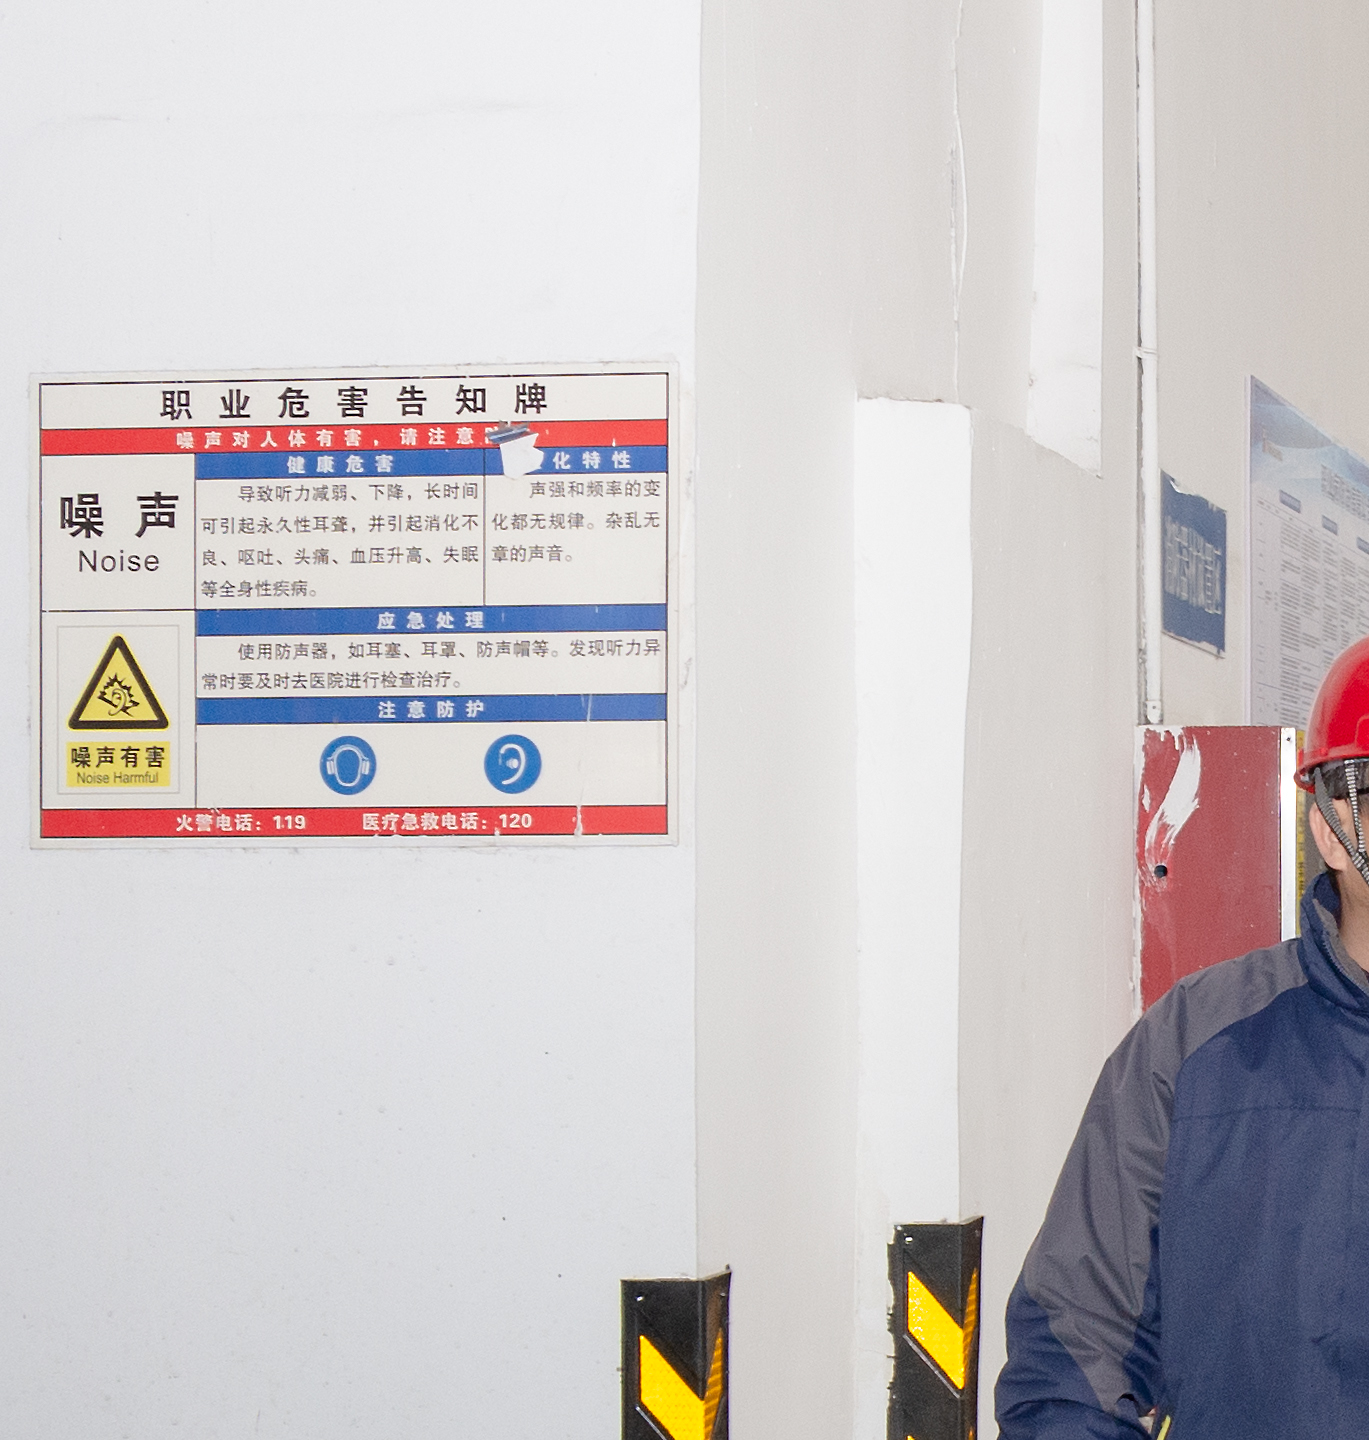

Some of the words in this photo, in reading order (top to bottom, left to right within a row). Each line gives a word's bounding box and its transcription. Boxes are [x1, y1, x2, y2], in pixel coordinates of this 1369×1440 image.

[159, 384, 548, 421] 职业危害告知牌
[286, 454, 394, 474] 健康危害
[538, 451, 631, 470] 化特性
[237, 482, 479, 504] 导致听力减弱、下降，长时间
[529, 479, 661, 499] 声强和频率的变
[60, 491, 179, 539] 噪声
[200, 513, 479, 535] 可引起永久性耳聋，并引起消化不
[491, 511, 660, 531] 化都无规律。杂乱无
[79, 549, 160, 573] Noise
[202, 545, 479, 567] 良、呕吐、头痛、血压升高、失眠
[491, 544, 574, 563] 章的声音。
[201, 579, 319, 599] 等全身性疾病。
[376, 611, 484, 630] 应急处理
[201, 670, 461, 690] 常时要及时去医院进行检查治疗。
[378, 699, 484, 719] 注意防护
[71, 745, 165, 769] 噪声有害
[76, 771, 110, 785] Noise
[113, 770, 159, 785] Harmful
